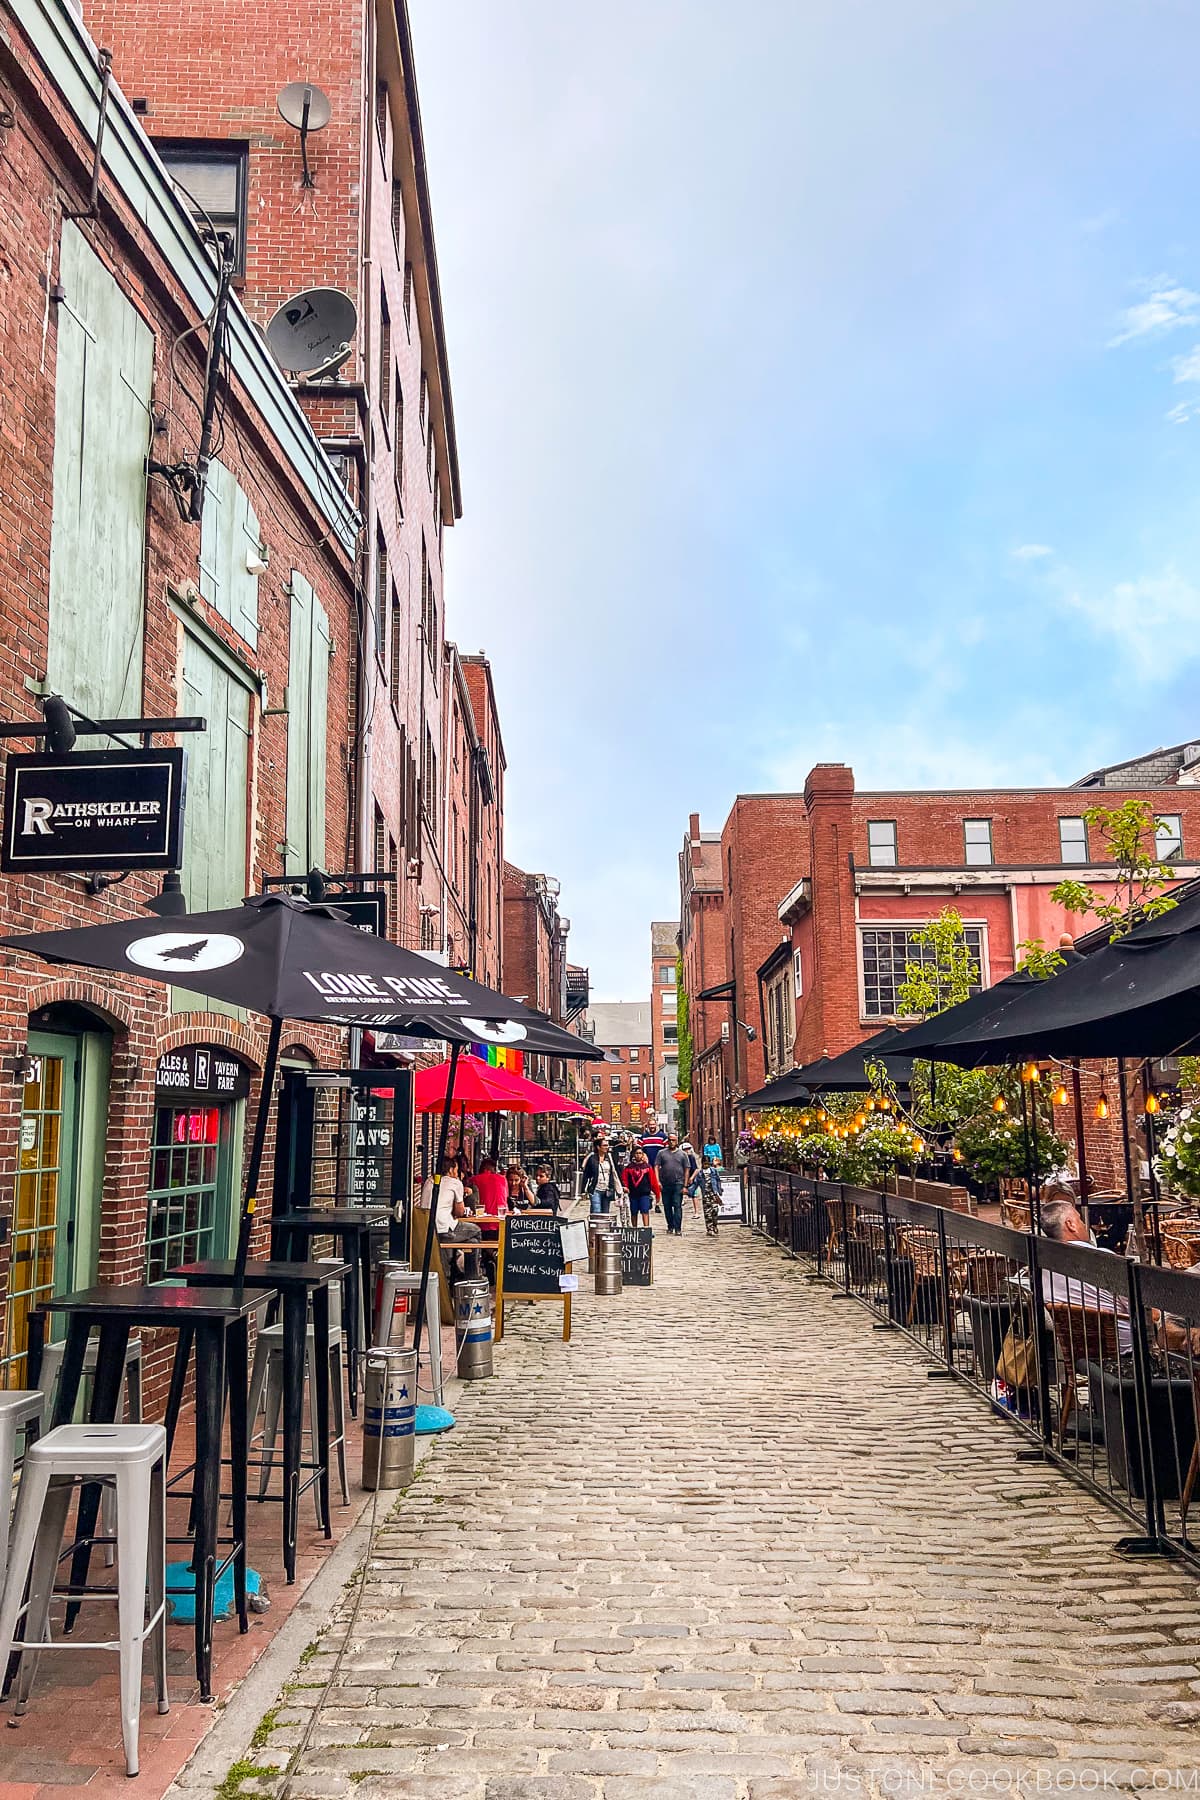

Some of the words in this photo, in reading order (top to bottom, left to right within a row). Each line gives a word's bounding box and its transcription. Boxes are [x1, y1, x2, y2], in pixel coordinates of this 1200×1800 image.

[21, 797, 161, 836] RATHSKELLER
[75, 818, 91, 828] ON
[97, 817, 138, 827] WHARF
[302, 971, 389, 996] LONE
[382, 975, 463, 998] PINE
[159, 1054, 180, 1071] ALES
[182, 1056, 189, 1071] &
[214, 1061, 239, 1078] TAVERN
[156, 1069, 190, 1087] LIQUORS
[217, 1075, 235, 1091] FARE
